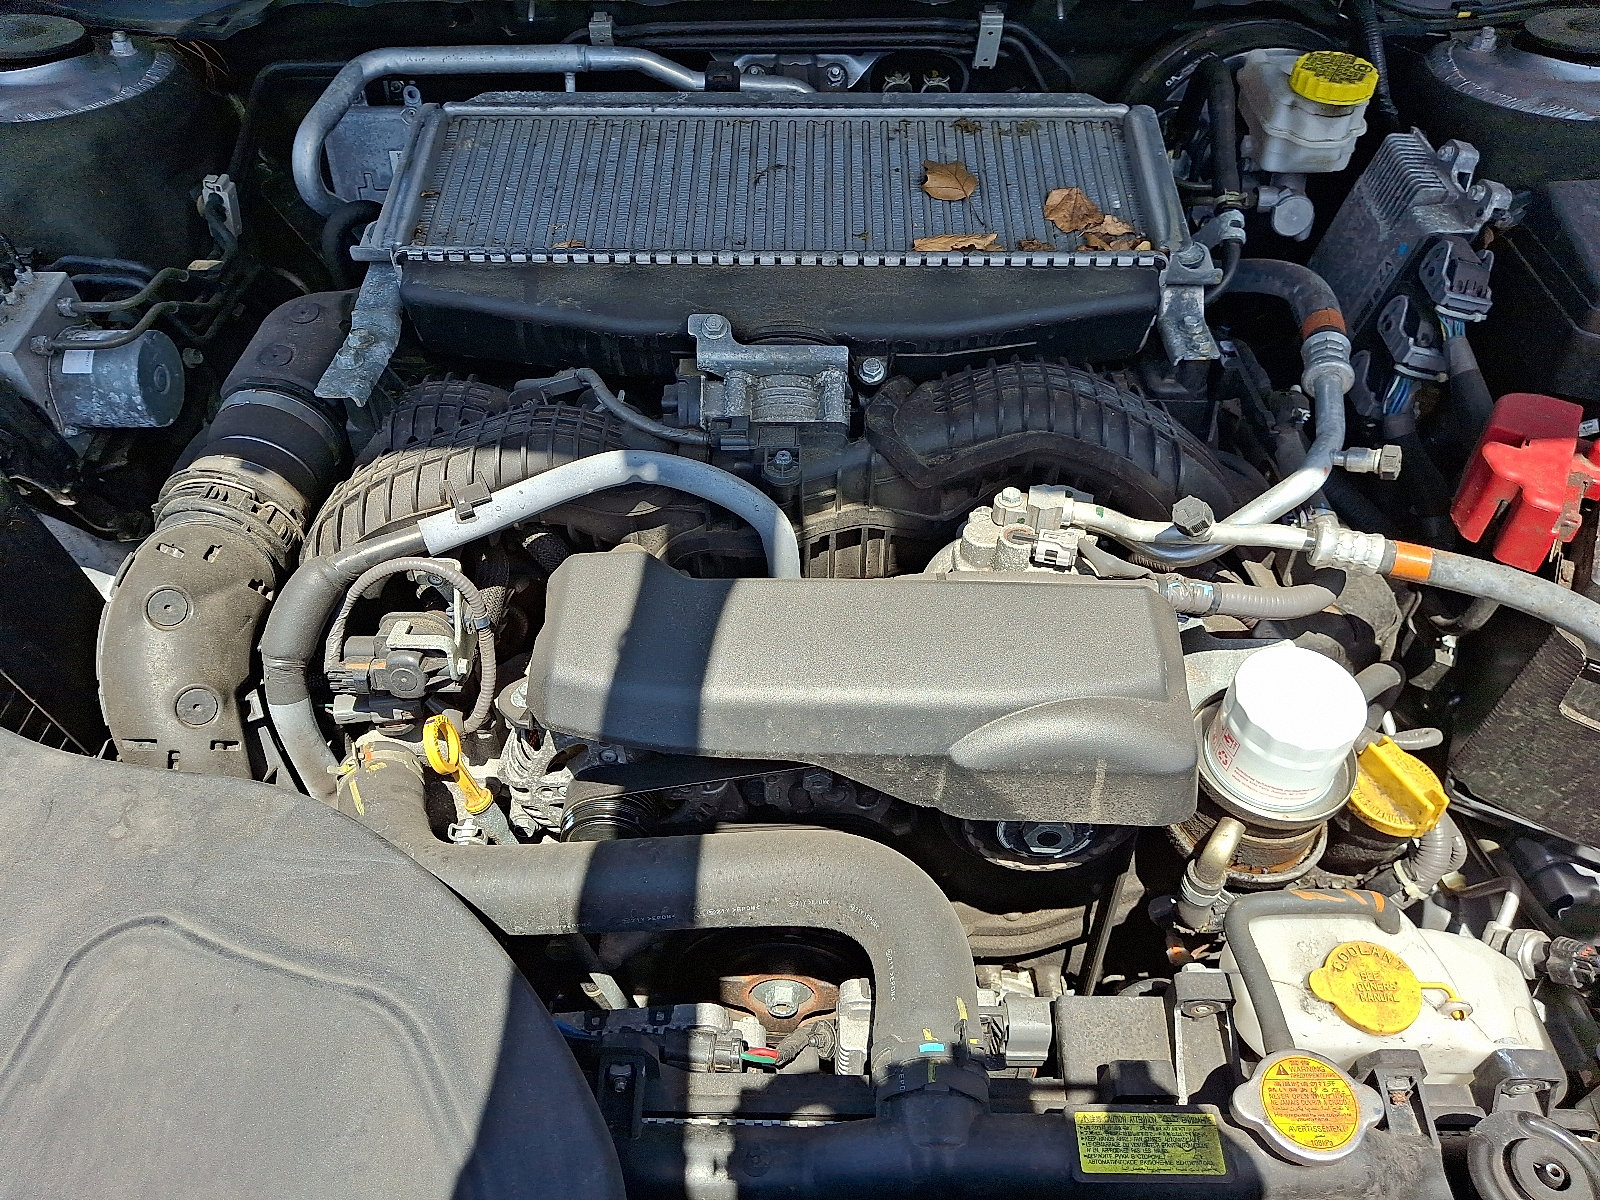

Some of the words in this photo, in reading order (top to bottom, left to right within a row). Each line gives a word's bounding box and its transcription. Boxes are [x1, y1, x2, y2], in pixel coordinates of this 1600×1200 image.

[1331, 945, 1407, 972] COOLANT
[1359, 971, 1381, 981] SEE
[1358, 993, 1401, 1003] MANUAL
